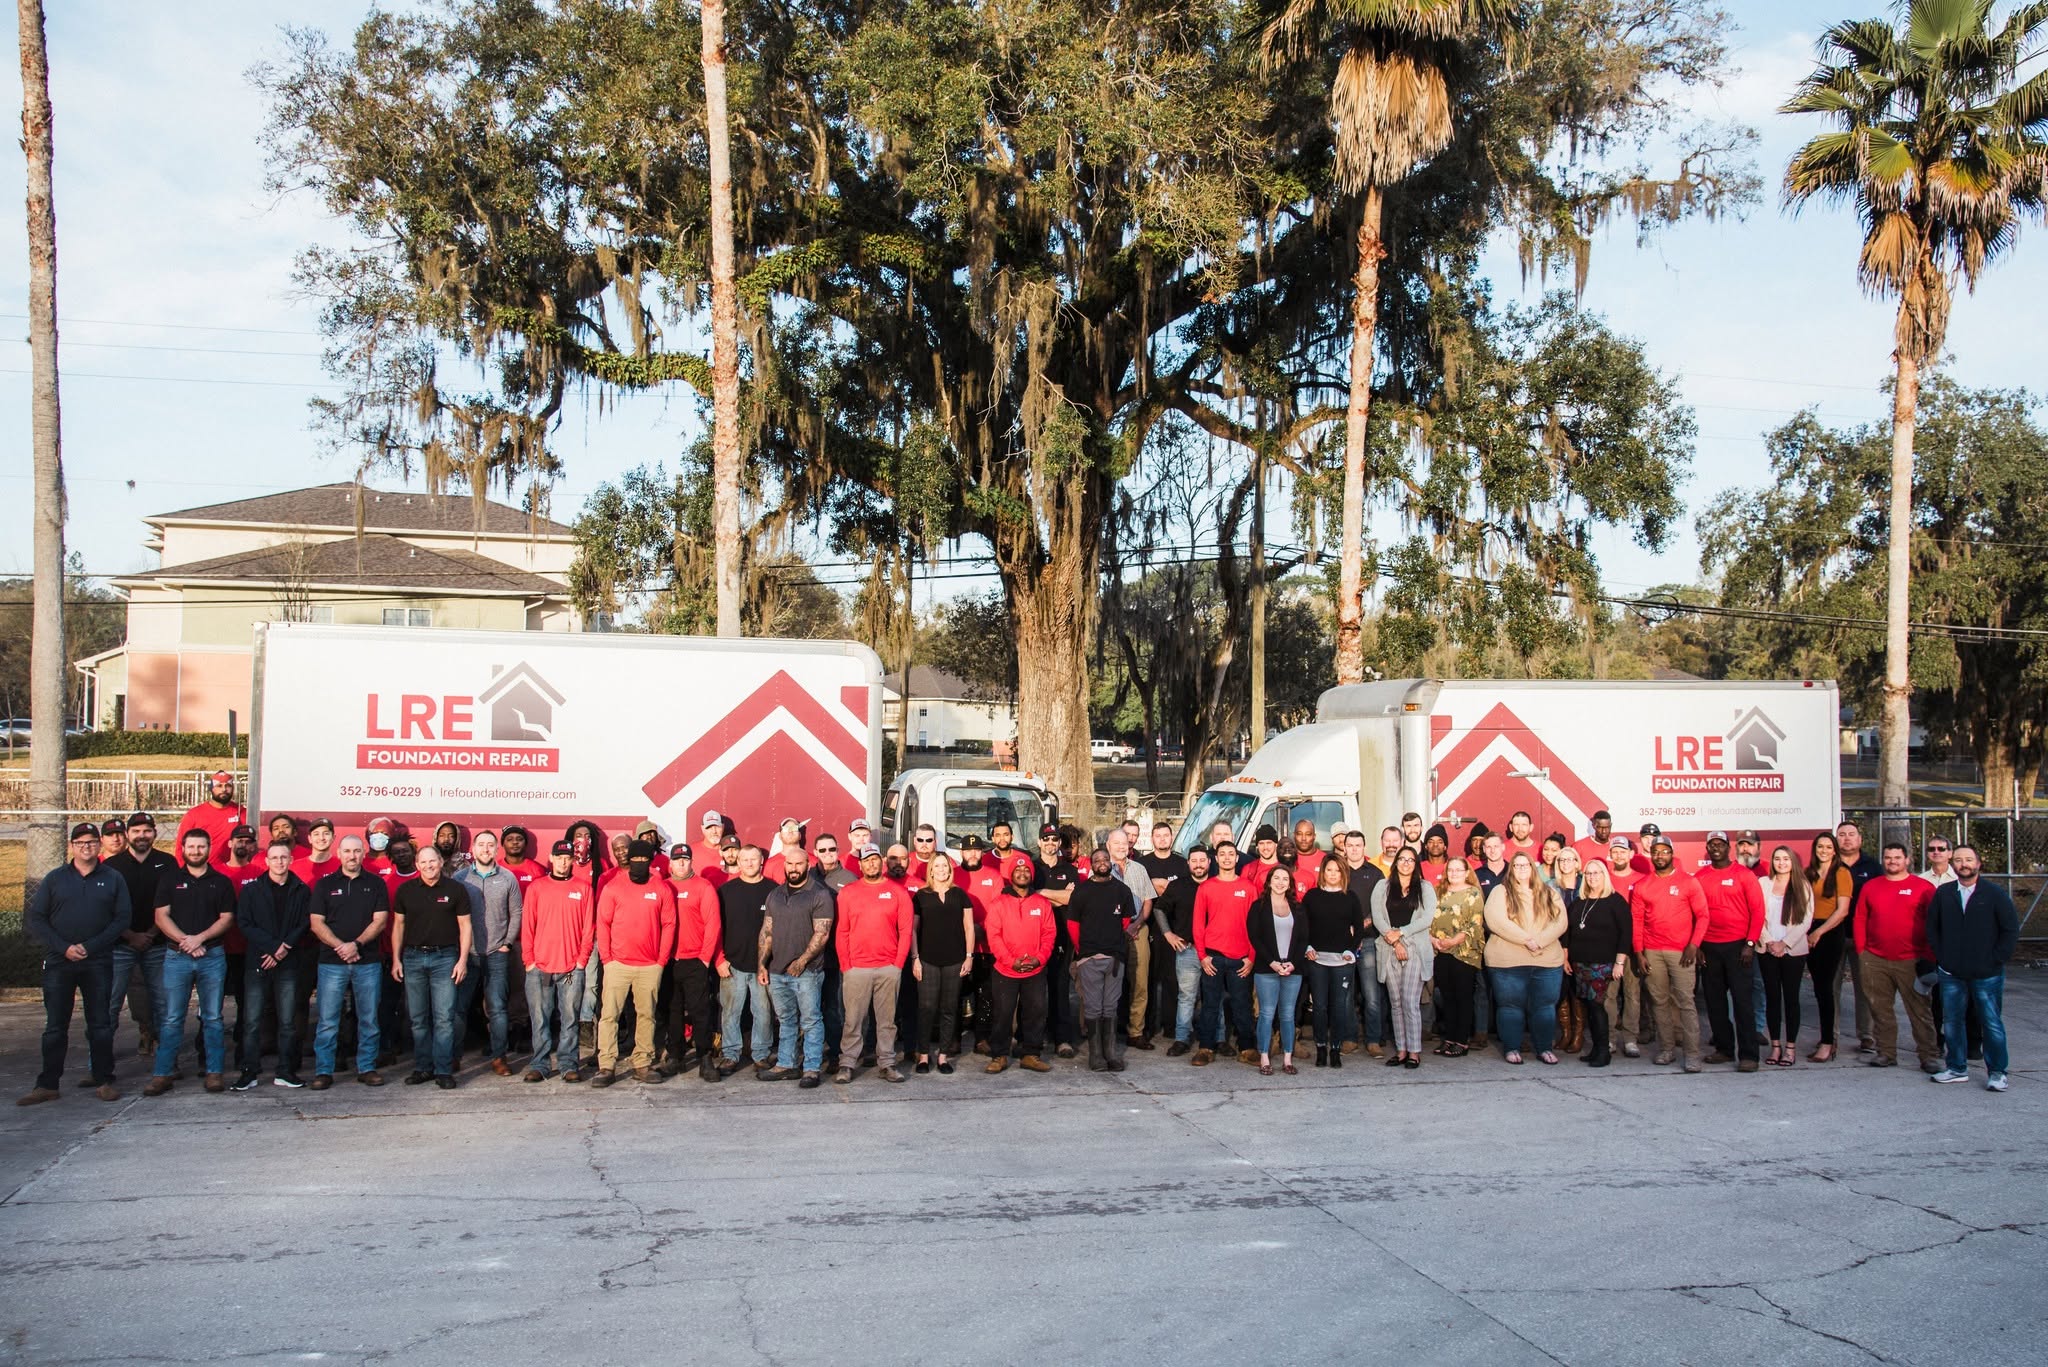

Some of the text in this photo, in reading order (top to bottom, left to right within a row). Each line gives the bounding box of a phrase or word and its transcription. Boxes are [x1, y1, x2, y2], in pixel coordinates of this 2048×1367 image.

[367, 693, 474, 740] LRE
[367, 750, 549, 767] FOUNDATION REPAIR
[1655, 736, 1723, 770] LRE
[1655, 777, 1782, 790] FOUNDATION REPAIR
[340, 785, 577, 800] 352-796-0229 lrefoundationrepair.com
[1639, 807, 1696, 816] 352-796-0229
[969, 836, 976, 846] P
